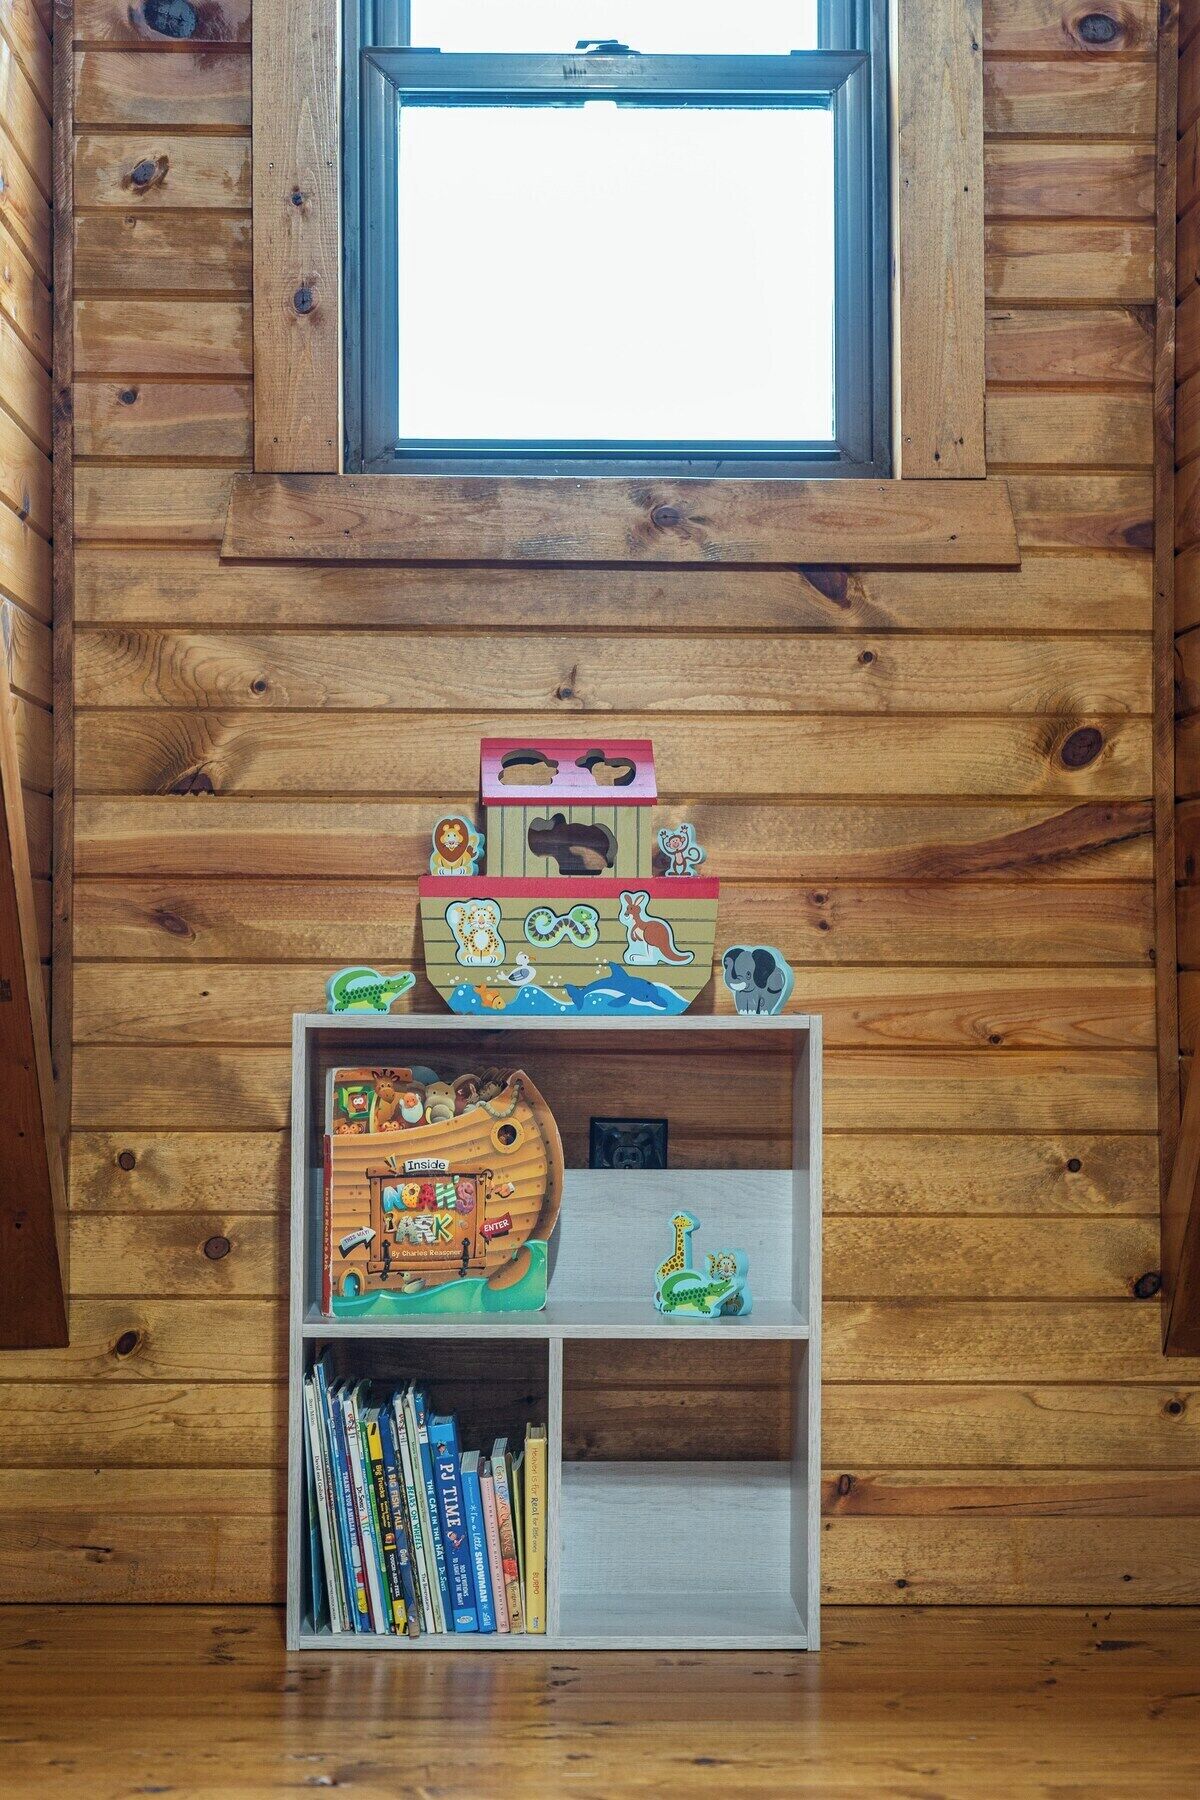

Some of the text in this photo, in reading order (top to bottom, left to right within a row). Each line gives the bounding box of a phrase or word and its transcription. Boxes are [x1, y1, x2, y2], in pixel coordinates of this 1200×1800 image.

[408, 1161, 446, 1170] Inside
[383, 1175, 475, 1215] NOAH'S
[396, 1213, 453, 1244] ARK
[484, 1219, 509, 1232] ENTER
[375, 1465, 385, 1498] Big Trucks
[389, 1474, 397, 1488] BIG
[391, 1490, 399, 1508] FISH
[440, 1463, 461, 1527] PJ TIME
[531, 1497, 539, 1515] Real
[347, 1508, 355, 1532] AMELIA
[360, 1515, 370, 1536] ABC
[394, 1511, 403, 1530] TALE
[406, 1485, 422, 1550] BEARS ON WHEELS
[432, 1516, 437, 1524] IN
[436, 1544, 444, 1560] HAT
[461, 1574, 469, 1597] DEVOTIONS
[474, 1552, 487, 1602] SNOWMAN
[422, 1583, 430, 1611] Berenstains
